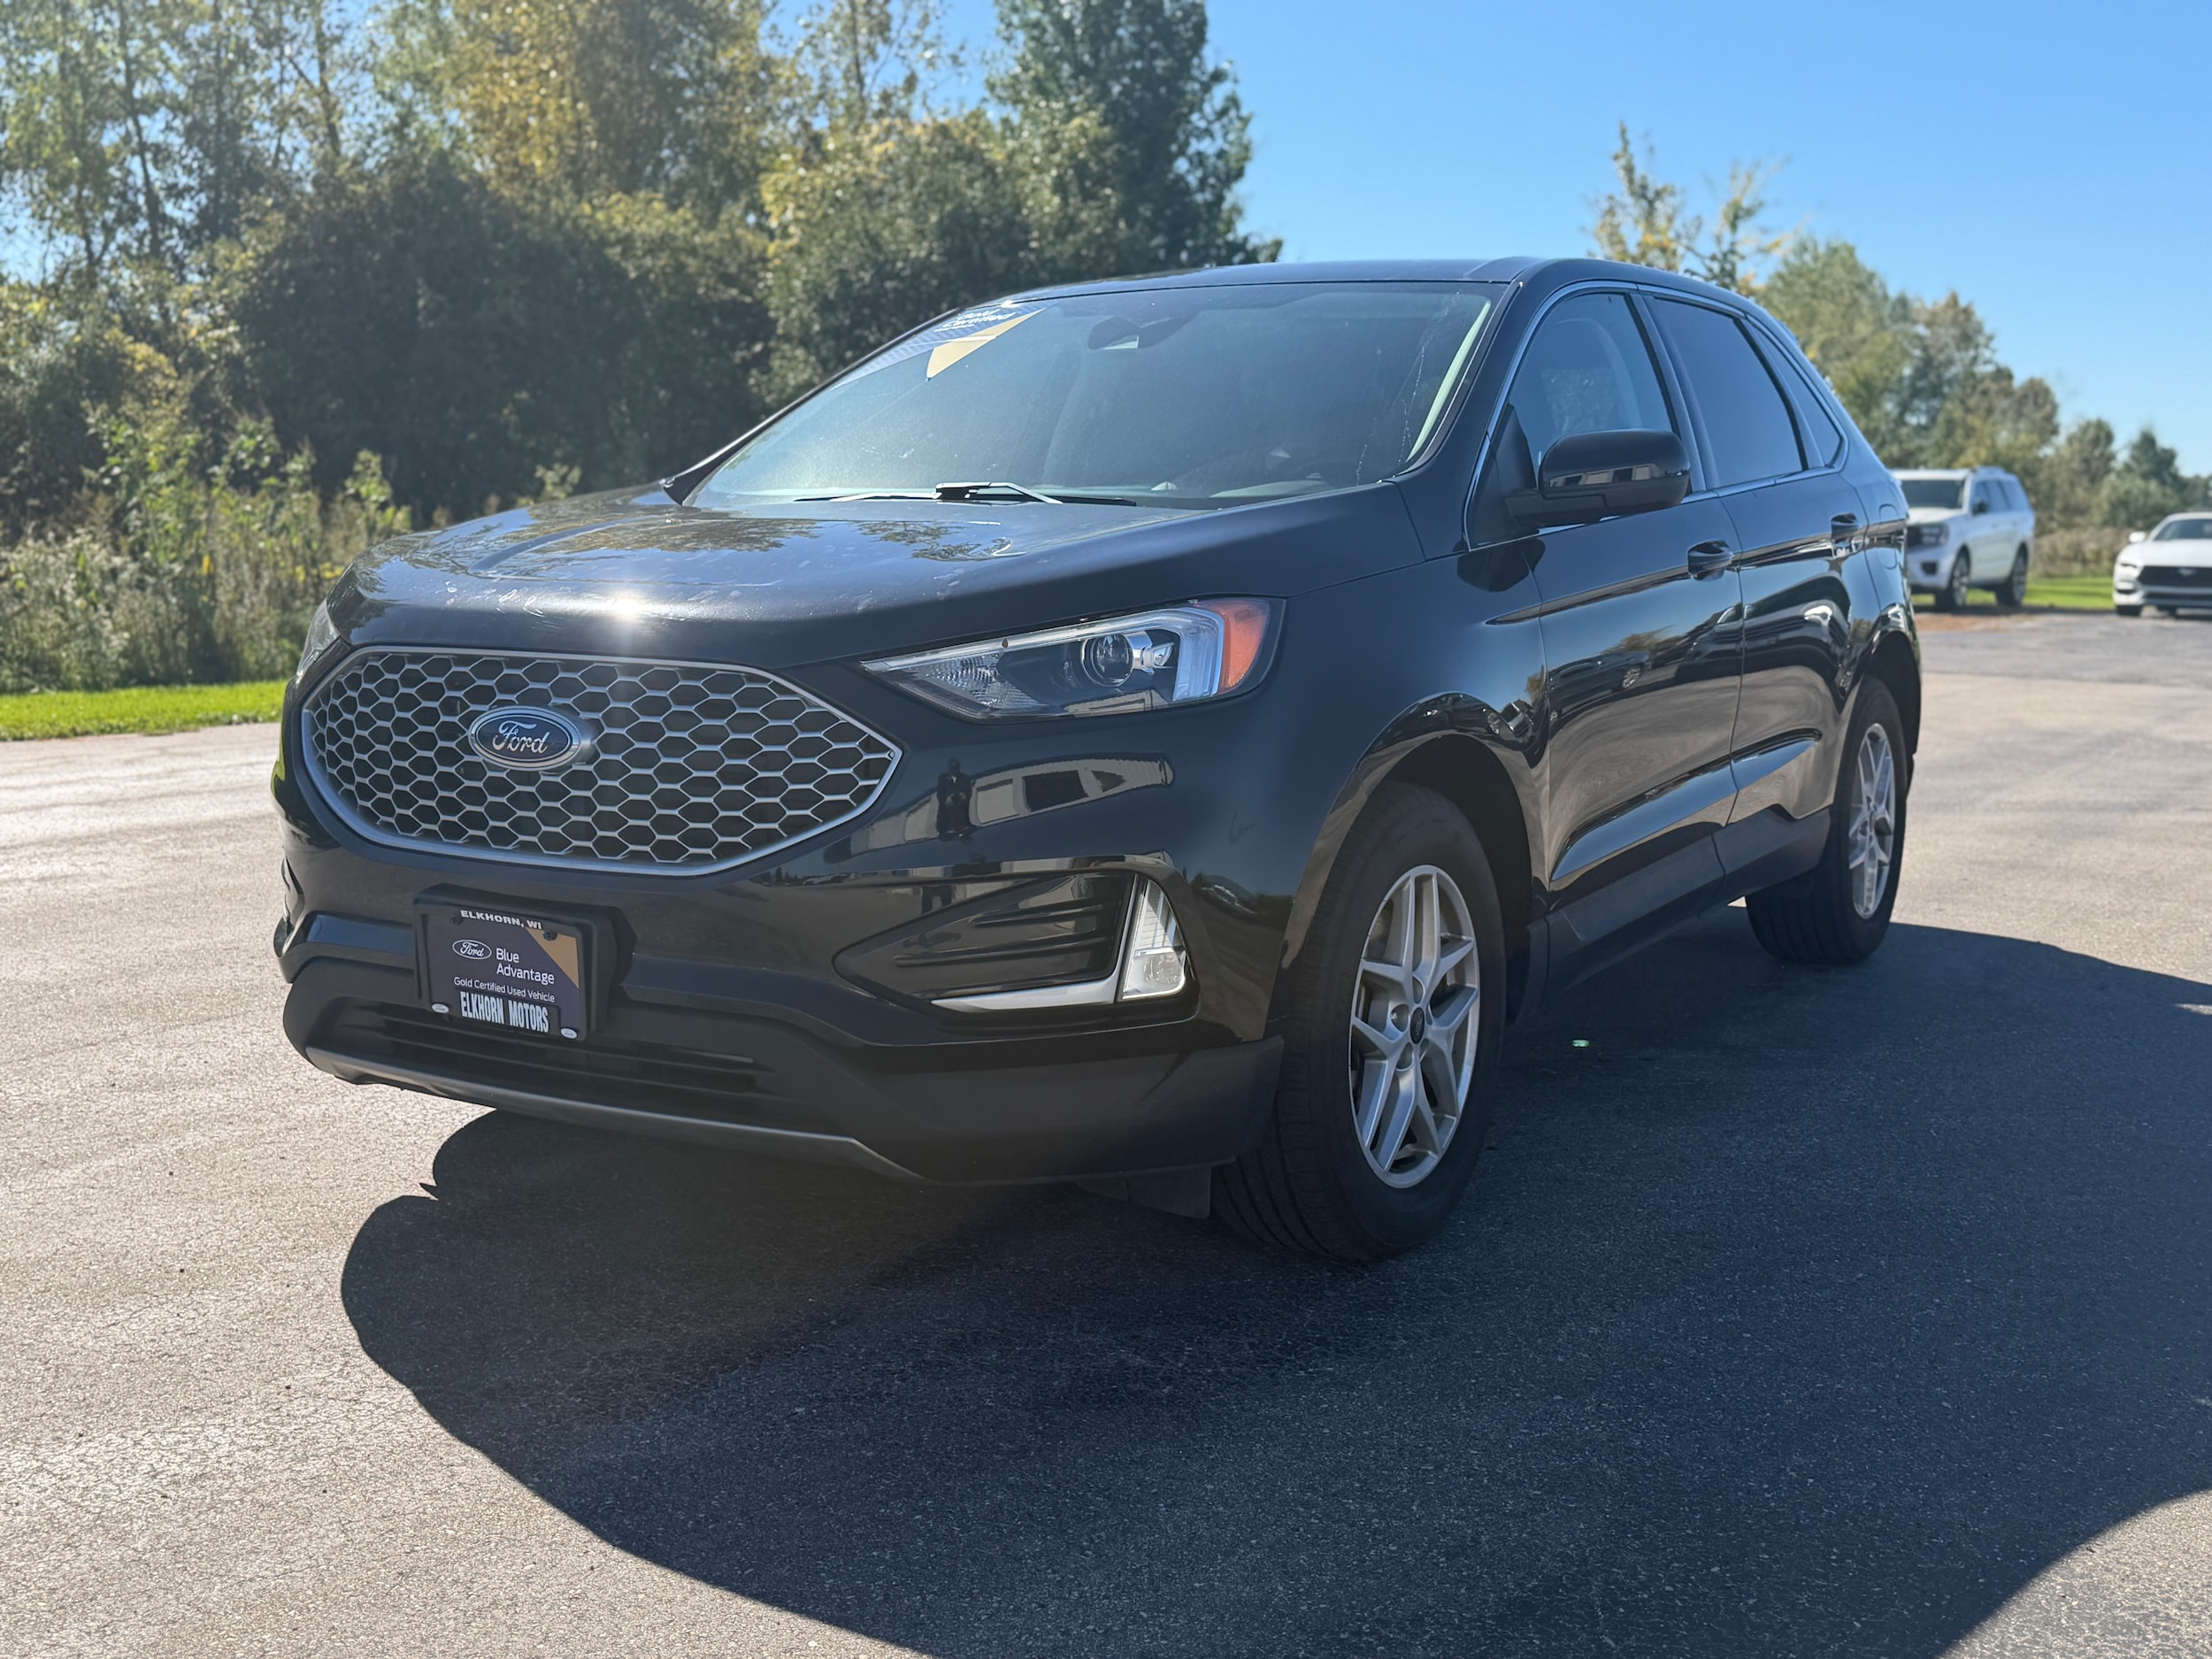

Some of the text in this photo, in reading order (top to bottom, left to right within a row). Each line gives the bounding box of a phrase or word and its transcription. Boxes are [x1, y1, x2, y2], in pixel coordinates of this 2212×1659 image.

[492, 720, 550, 754] Ford
[460, 910, 542, 930] ELKHORN, WI
[460, 941, 485, 957] Ford
[495, 948, 519, 964] Blue
[496, 963, 555, 986] Advantage
[454, 977, 555, 1002] Gold Certified Used Vehicle
[460, 991, 549, 1033] ELKHORN MOTORS
